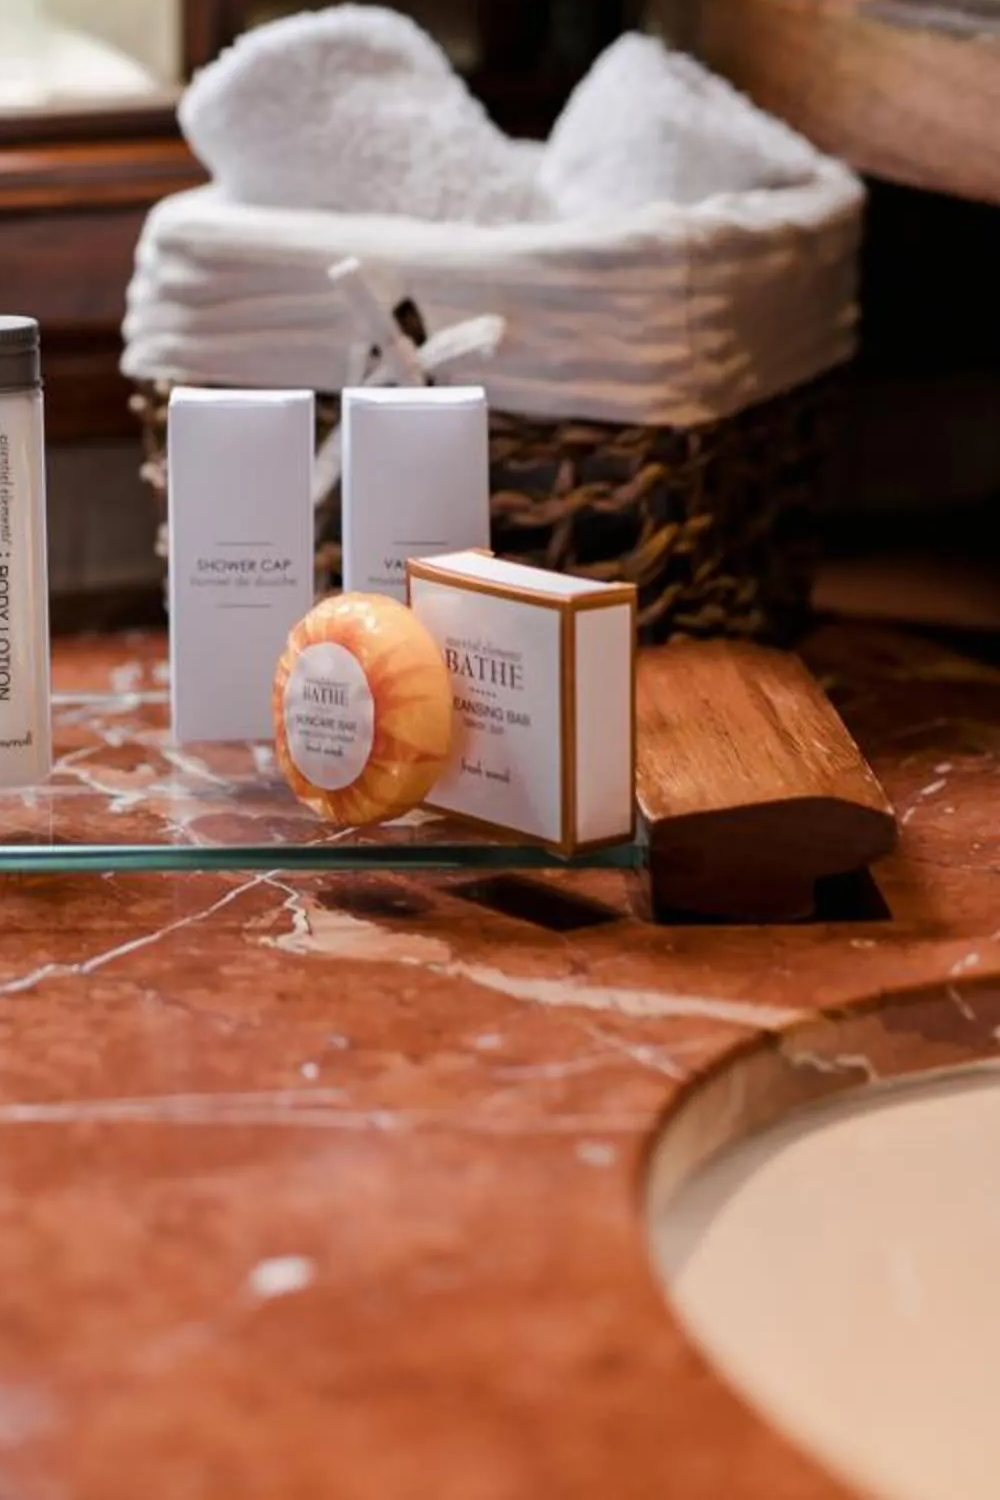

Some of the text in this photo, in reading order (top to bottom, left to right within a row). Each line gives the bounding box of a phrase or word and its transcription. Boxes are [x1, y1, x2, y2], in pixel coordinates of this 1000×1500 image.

[197, 558, 292, 573] SHOWER CAP
[445, 648, 524, 690] BATHE
[506, 709, 532, 727] BAR
